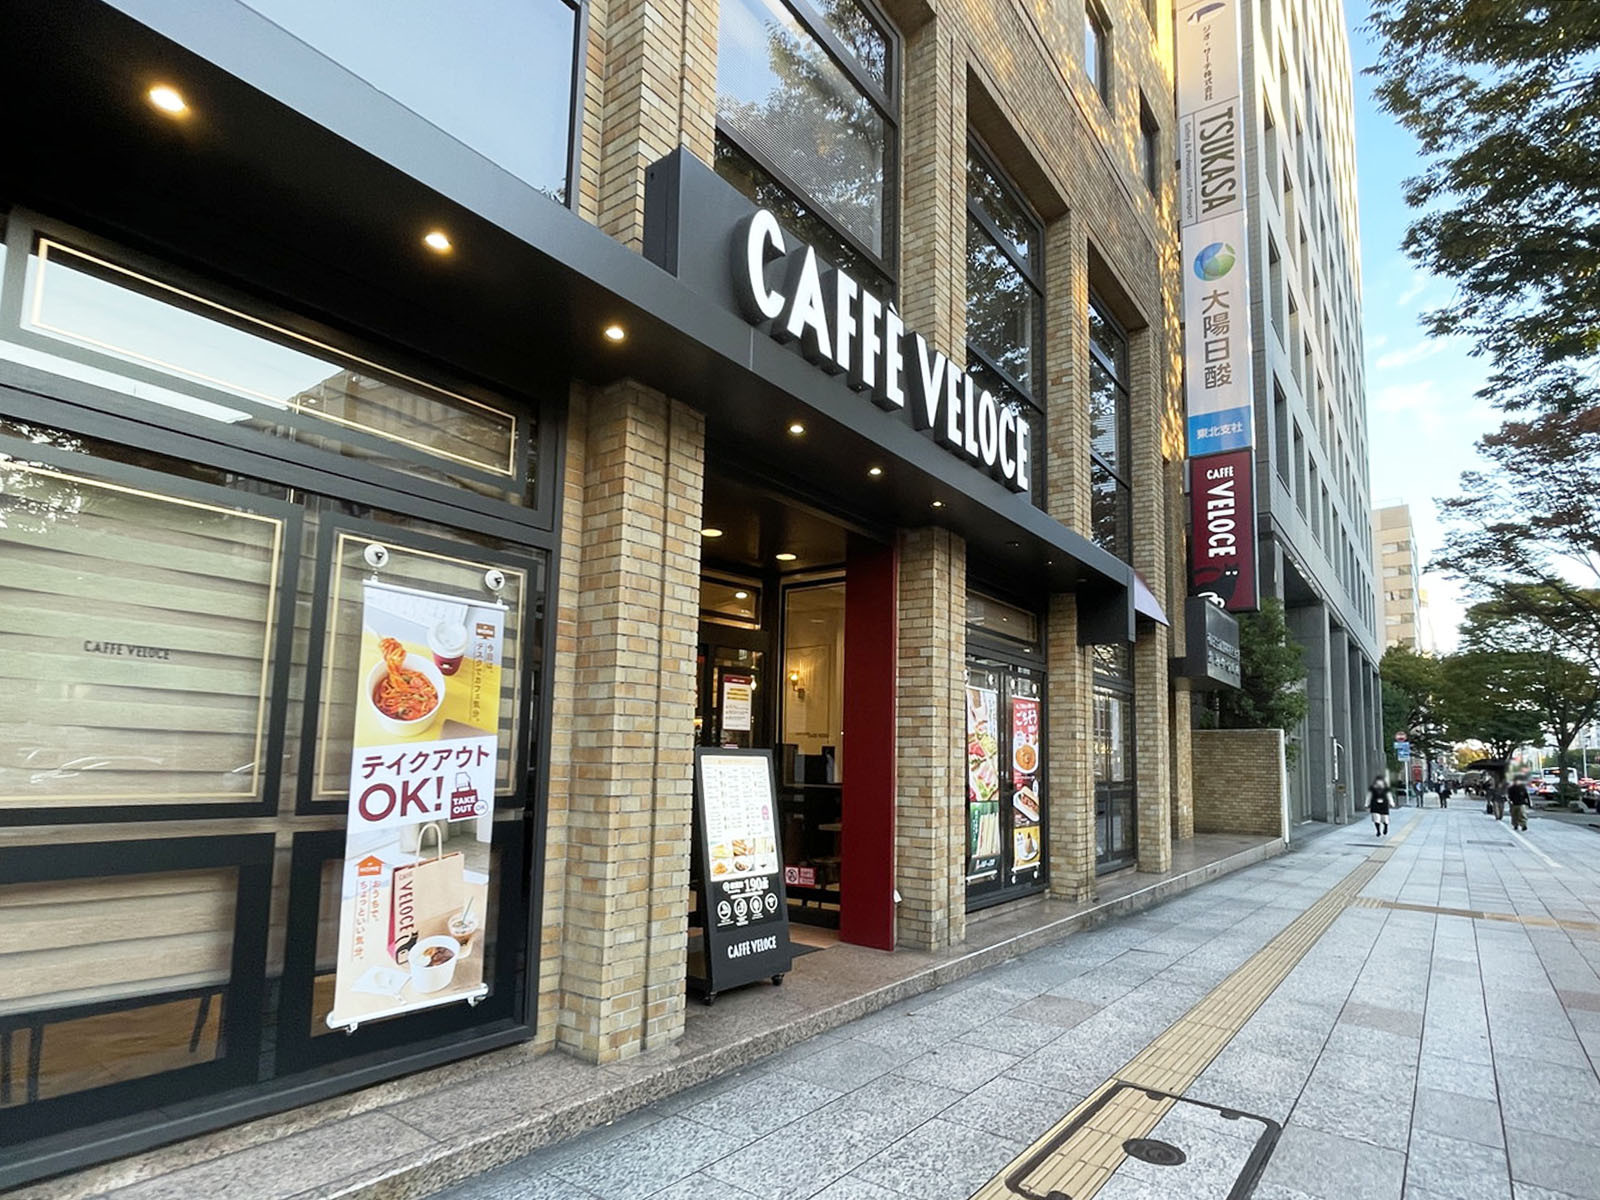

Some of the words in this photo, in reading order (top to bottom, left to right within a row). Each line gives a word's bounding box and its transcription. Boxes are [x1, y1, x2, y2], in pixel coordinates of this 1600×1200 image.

[1200, 106, 1236, 214] TSUKASA
[1202, 289, 1232, 390] 大陽日酸
[916, 332, 1030, 492] VELOCE
[1197, 422, 1243, 440] 東北支社
[1207, 480, 1237, 558] VELOCE
[126, 644, 170, 660] VELOCE
[361, 745, 490, 779] テイクアウト
[358, 776, 444, 822] OK!
[452, 795, 477, 806] TAKE
[452, 805, 473, 814] OUT
[398, 880, 415, 933] VELOCE
[751, 935, 777, 953] VELOCE
